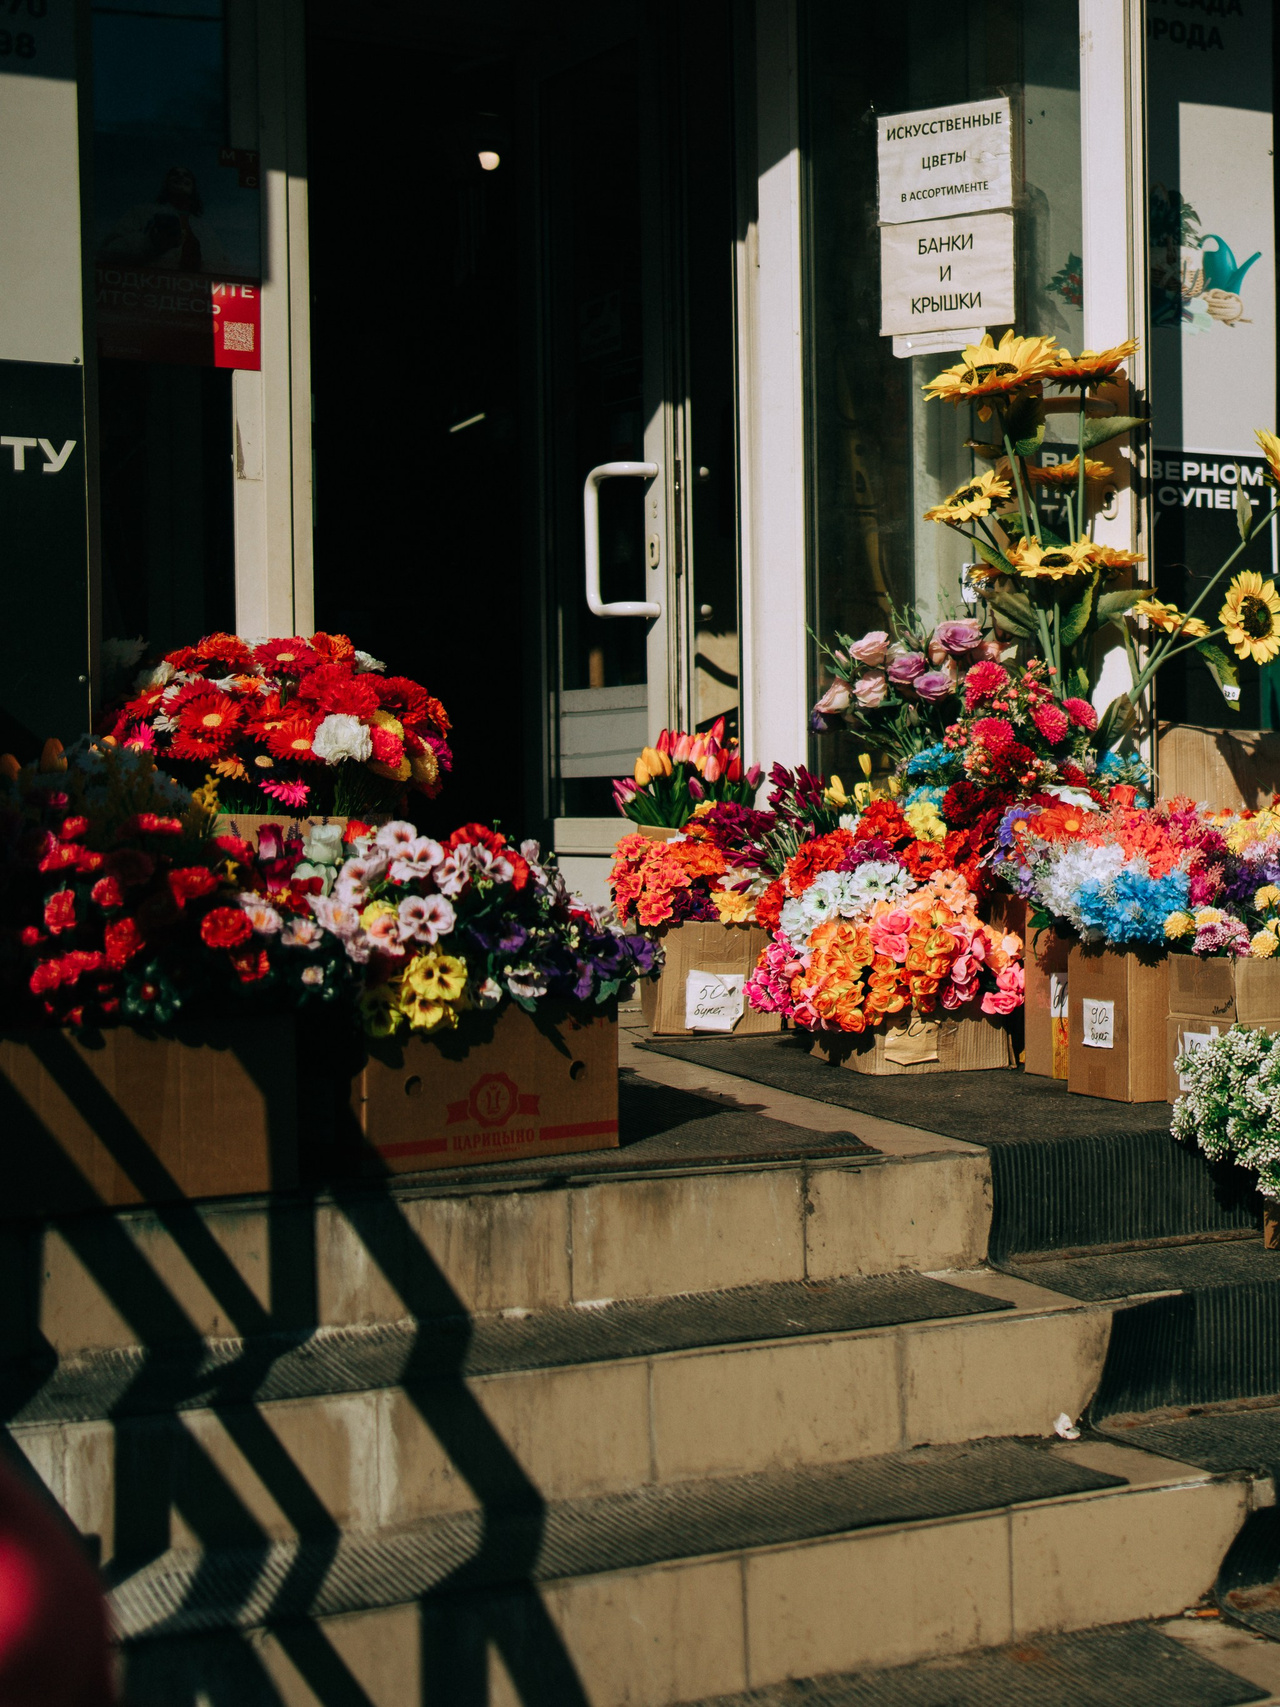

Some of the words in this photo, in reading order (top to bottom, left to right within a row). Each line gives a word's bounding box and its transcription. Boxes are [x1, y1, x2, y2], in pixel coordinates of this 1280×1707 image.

[1147, 18, 1224, 51] РОДА
[887, 112, 1002, 141] ИСКУССТВЕННЫЕ
[922, 151, 966, 171] ЦВЕТЫ
[901, 193, 907, 203] В
[909, 181, 989, 201] АССОРТИМЕНТЕ
[918, 233, 973, 255] БАНКИ
[939, 265, 951, 282] И
[911, 292, 982, 314] КРЫШКИ
[453, 1128, 535, 1151] ЦАРИЦЫНО
